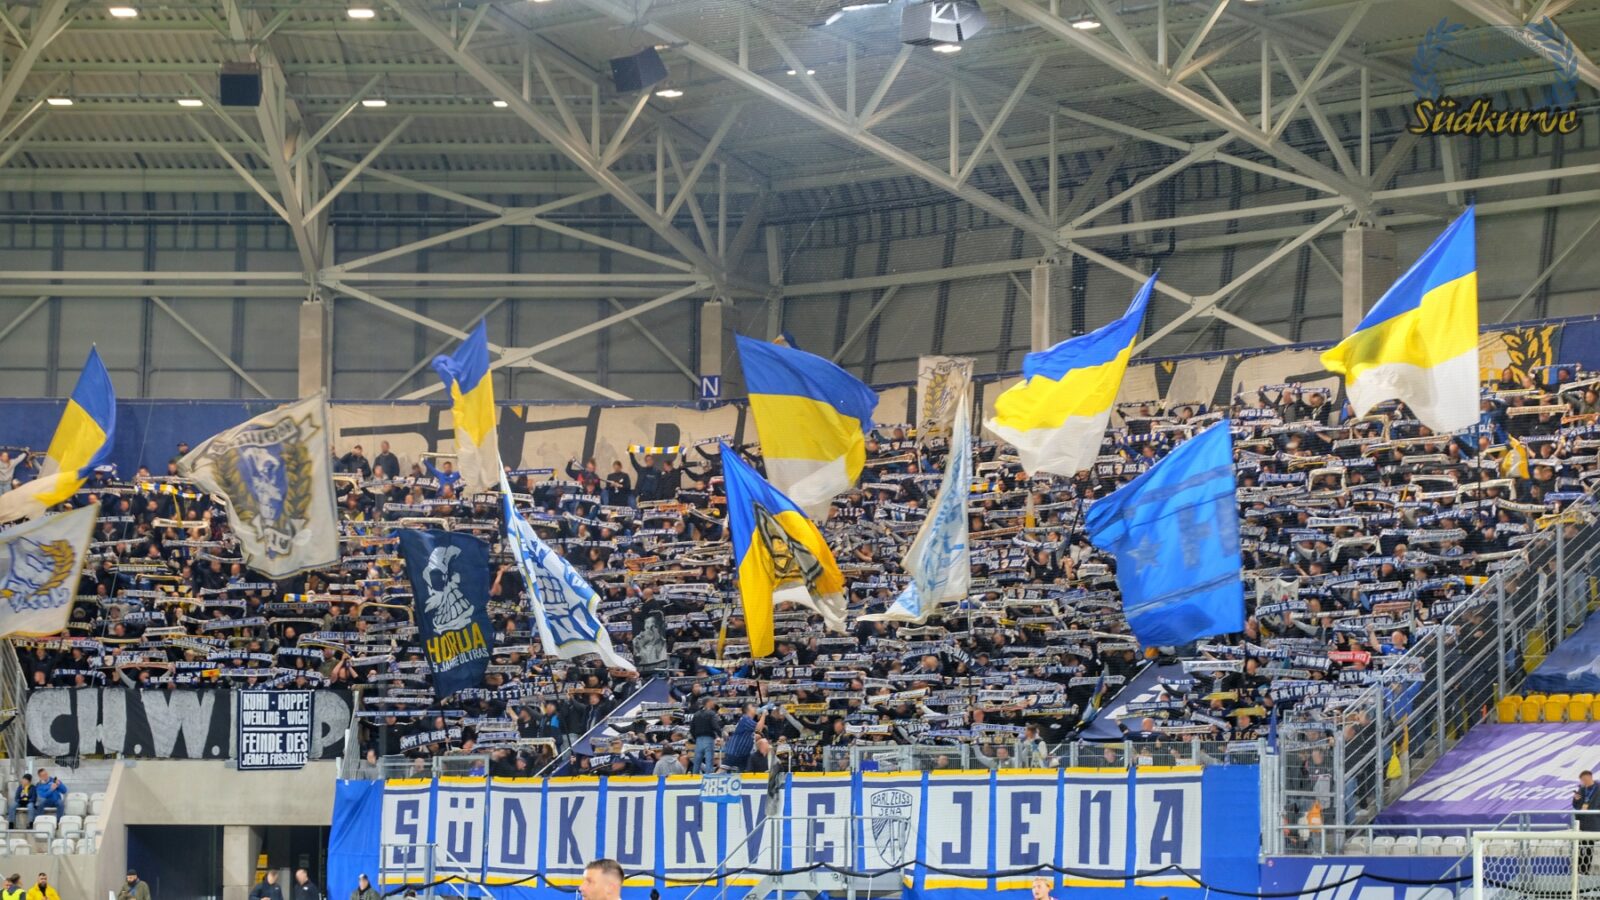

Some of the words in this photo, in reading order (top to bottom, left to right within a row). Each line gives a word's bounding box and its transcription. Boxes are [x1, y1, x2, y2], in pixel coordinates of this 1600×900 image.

[702, 377, 718, 396] N
[458, 647, 489, 664] ULTRAS
[243, 693, 269, 710] KUHN
[278, 693, 309, 710] KOPPE
[287, 710, 309, 725] WICK
[242, 732, 284, 753] FEINDE
[286, 732, 308, 753] DES
[873, 792, 889, 805] CARL
[890, 791, 910, 805] ZEISS
[879, 808, 902, 816] JENA
[393, 792, 835, 865] SÜDKURVE
[941, 788, 1184, 866] JENA
